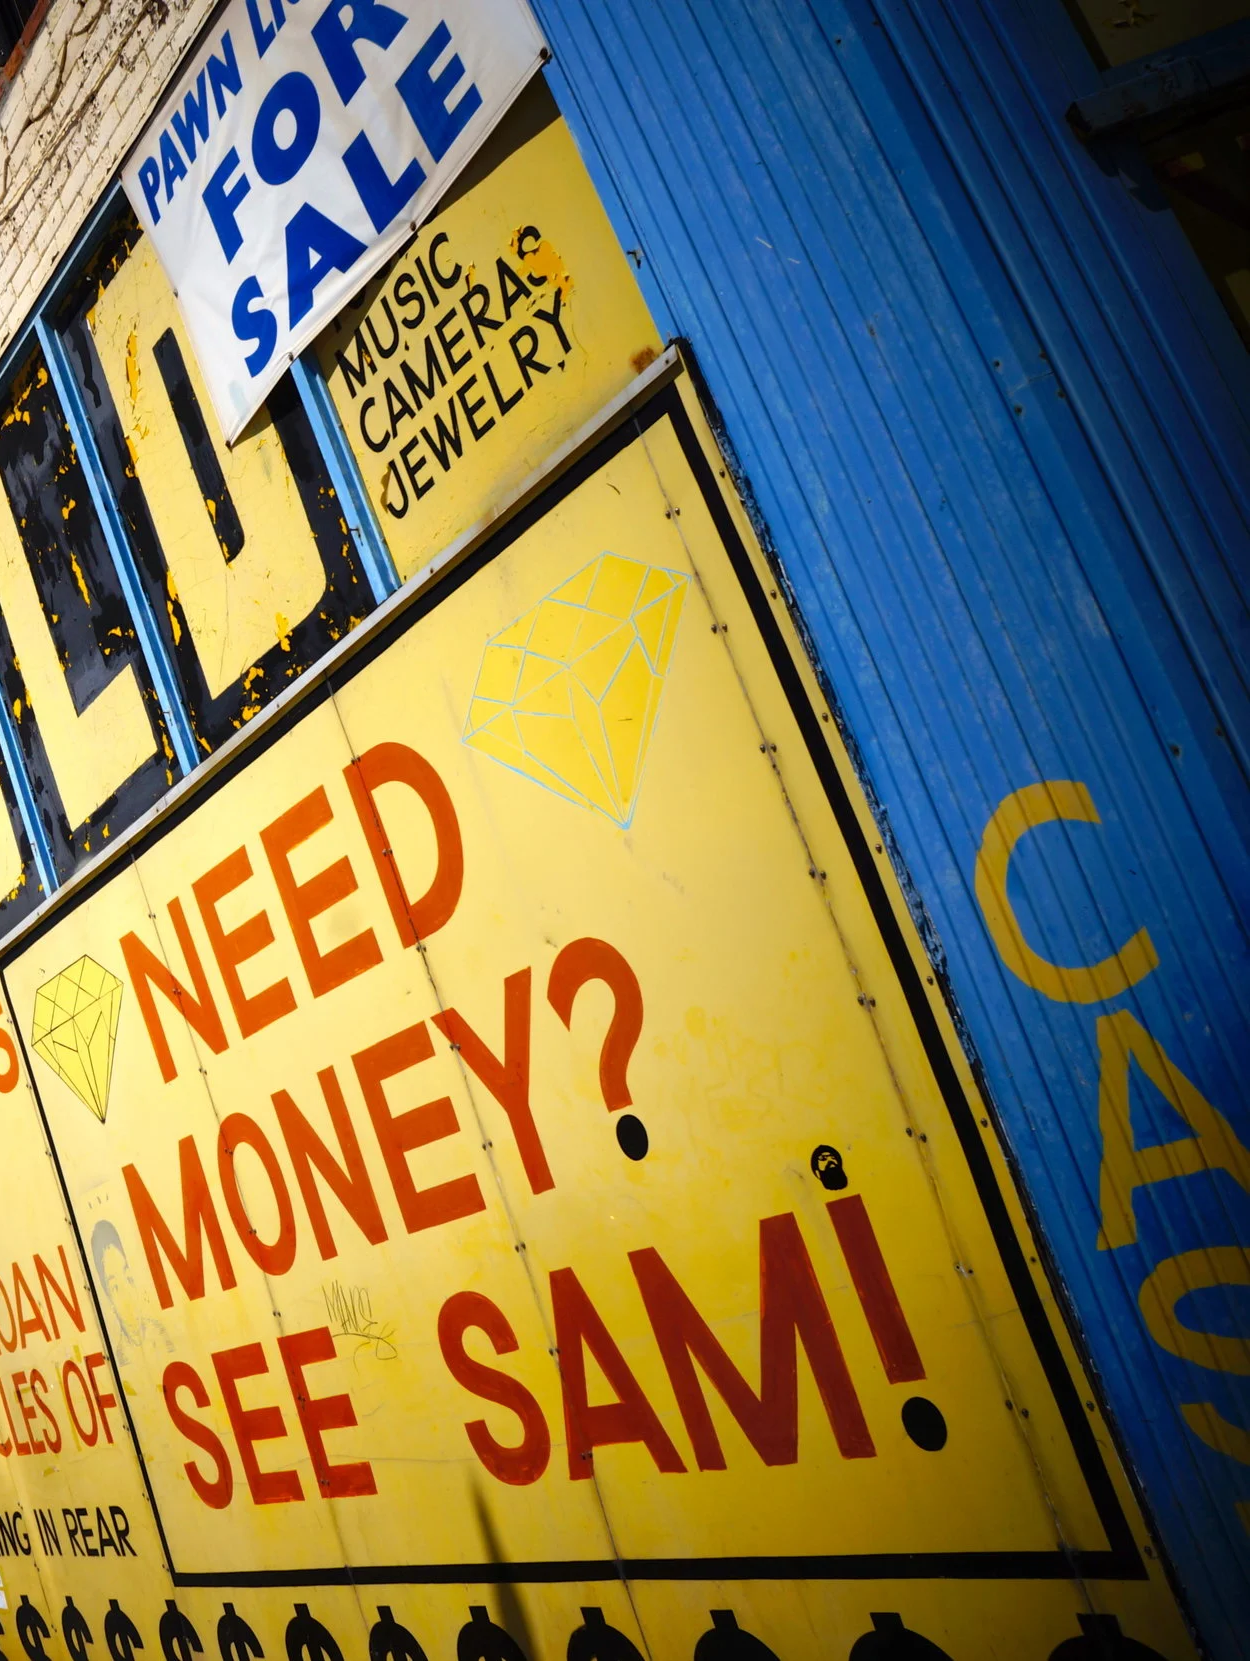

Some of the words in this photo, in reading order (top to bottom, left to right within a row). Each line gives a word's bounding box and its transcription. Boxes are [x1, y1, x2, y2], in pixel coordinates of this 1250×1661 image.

[137, 29, 242, 225] PAWN
[202, 0, 409, 265] FOR
[231, 20, 483, 378] SALE
[335, 232, 462, 399] MUSIC
[359, 225, 548, 453] CAMERAS
[385, 287, 572, 519] JEWELRY
[119, 741, 464, 1085] NEED
[121, 936, 649, 1310] MONEY?
[975, 779, 1250, 1541] CAS
[61, 1352, 117, 1447] OF
[163, 1326, 378, 1510] SEE
[437, 1195, 947, 1486] SAM!
[33, 1509, 63, 1557] IN
[61, 1505, 138, 1557] REAR
